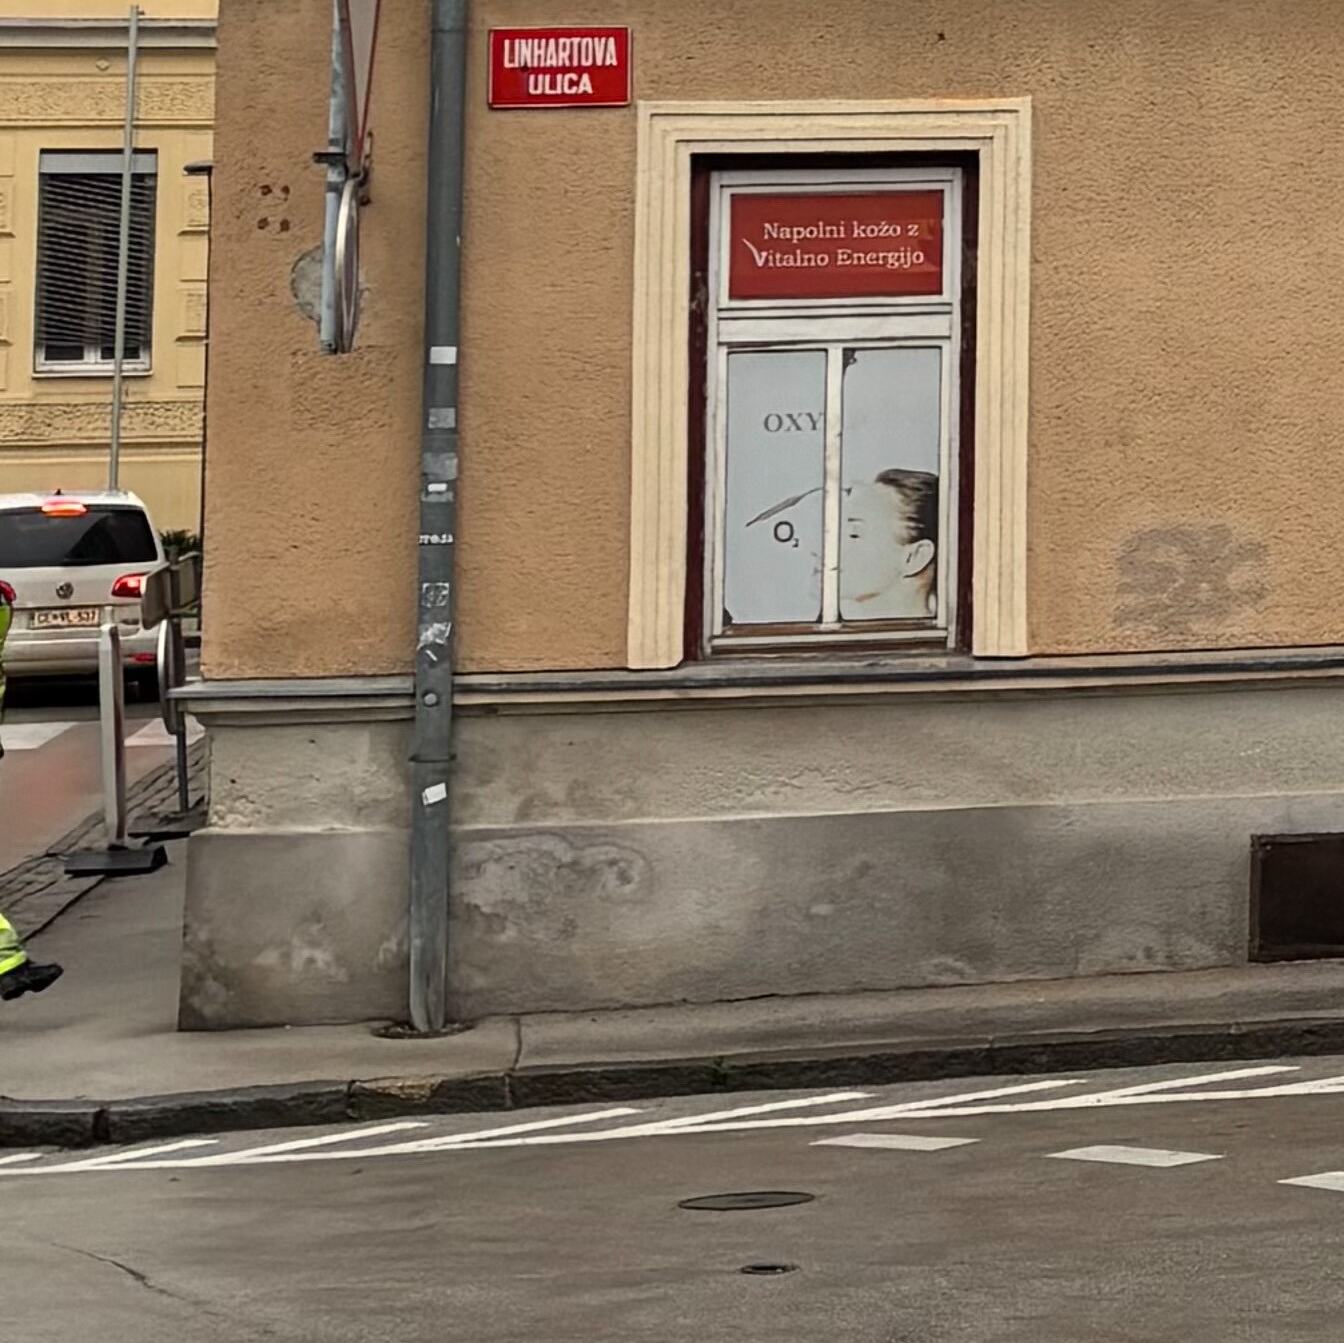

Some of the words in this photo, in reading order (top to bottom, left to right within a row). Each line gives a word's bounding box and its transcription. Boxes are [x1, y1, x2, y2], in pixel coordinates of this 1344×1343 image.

[504, 37, 618, 68] LINHARTOVA
[528, 72, 593, 95] ULICA
[763, 221, 846, 243] Napolni
[852, 220, 901, 238] kožo
[907, 222, 920, 237] z
[742, 238, 829, 268] Vitalno
[836, 247, 925, 269] Energijo
[763, 412, 824, 433] OXY
